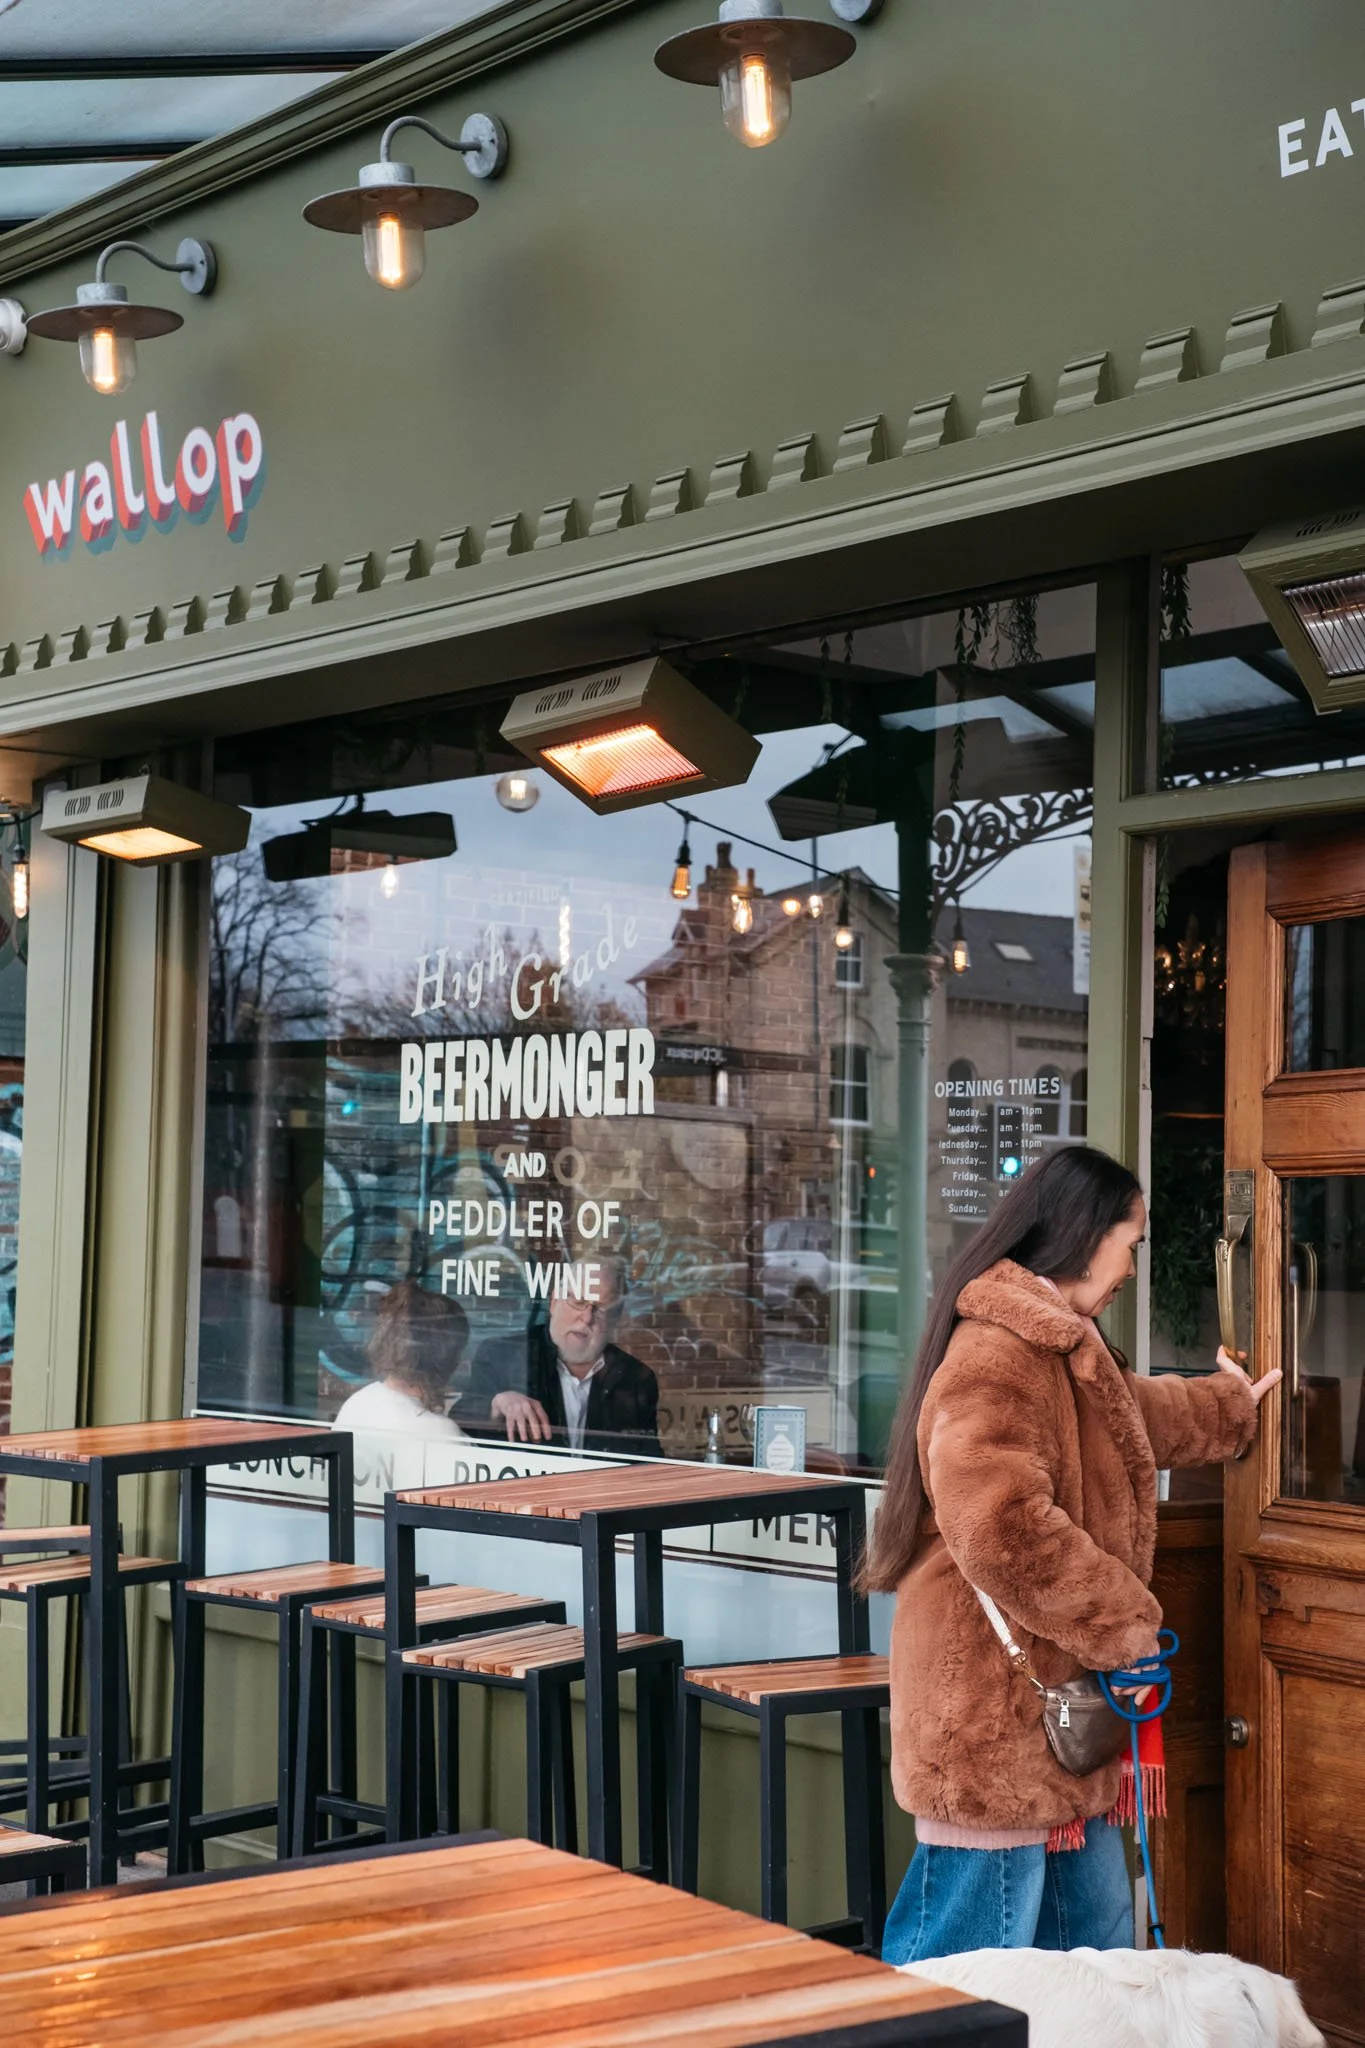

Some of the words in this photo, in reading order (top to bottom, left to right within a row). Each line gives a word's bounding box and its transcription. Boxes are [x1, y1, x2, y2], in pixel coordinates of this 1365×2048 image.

[23, 410, 264, 555] wallop
[411, 921, 507, 1018] High
[510, 902, 639, 1021] Grade
[400, 1027, 656, 1124] BEERMONGER
[934, 1079, 1004, 1098] OPENING
[1008, 1076, 1060, 1095] TIMES
[503, 1152, 547, 1179] AND
[938, 1140, 988, 1150] ednesday...
[429, 1200, 564, 1238] PEDDLER
[577, 1200, 621, 1240] OF
[441, 1258, 500, 1297] FINE
[525, 1262, 601, 1300] WINE
